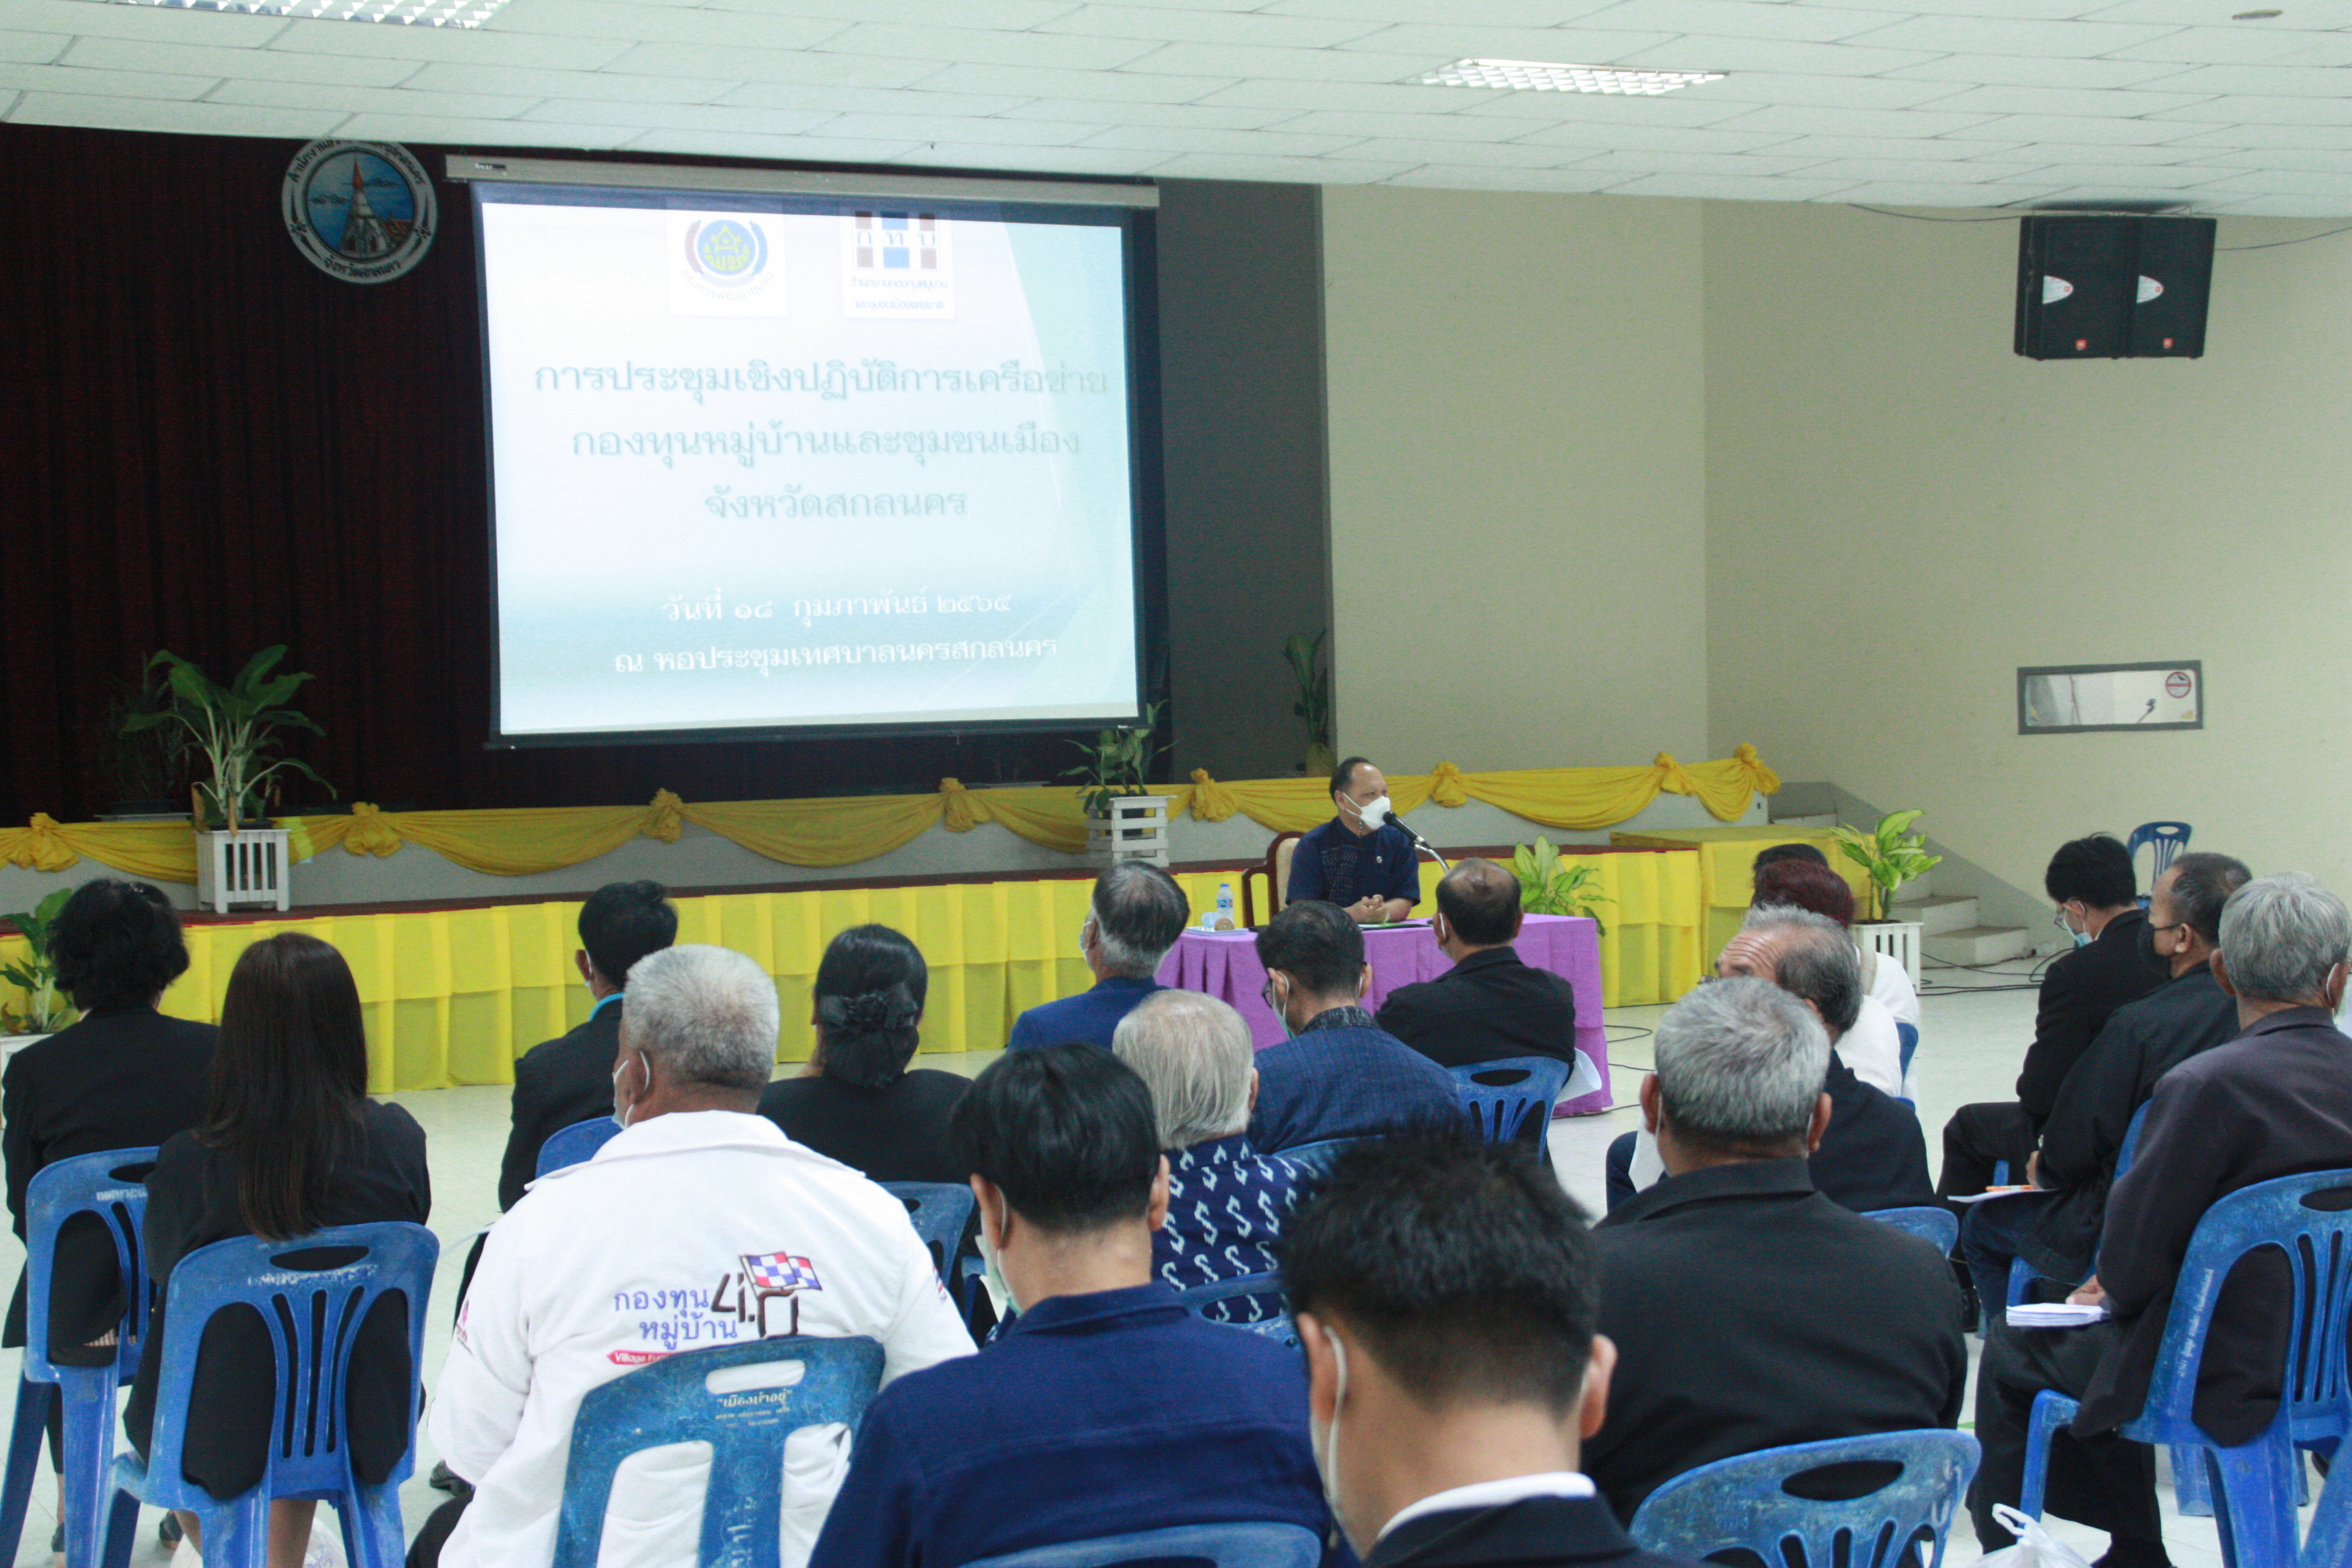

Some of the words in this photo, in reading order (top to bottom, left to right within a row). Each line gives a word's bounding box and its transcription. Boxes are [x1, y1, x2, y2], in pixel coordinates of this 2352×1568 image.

[535, 358, 1108, 405] การประชุมเชิงปฏิบัติการเครือข่าย
[573, 419, 1080, 469] กองทุนหมู่บ้านและชุมชนเมือง
[705, 483, 966, 518] จังหวัดสกลนคร
[663, 586, 722, 621] วันที่
[734, 601, 772, 619] ๑๘
[794, 586, 928, 628] กุมภาพันธ์
[615, 654, 644, 672] ณ
[654, 639, 1058, 678] หอประชุมเทศบาลนครสกลนคร
[614, 1289, 709, 1318] กองทุน
[639, 1311, 738, 1350] หมู่บ้าน
[615, 1352, 646, 1364] Village
